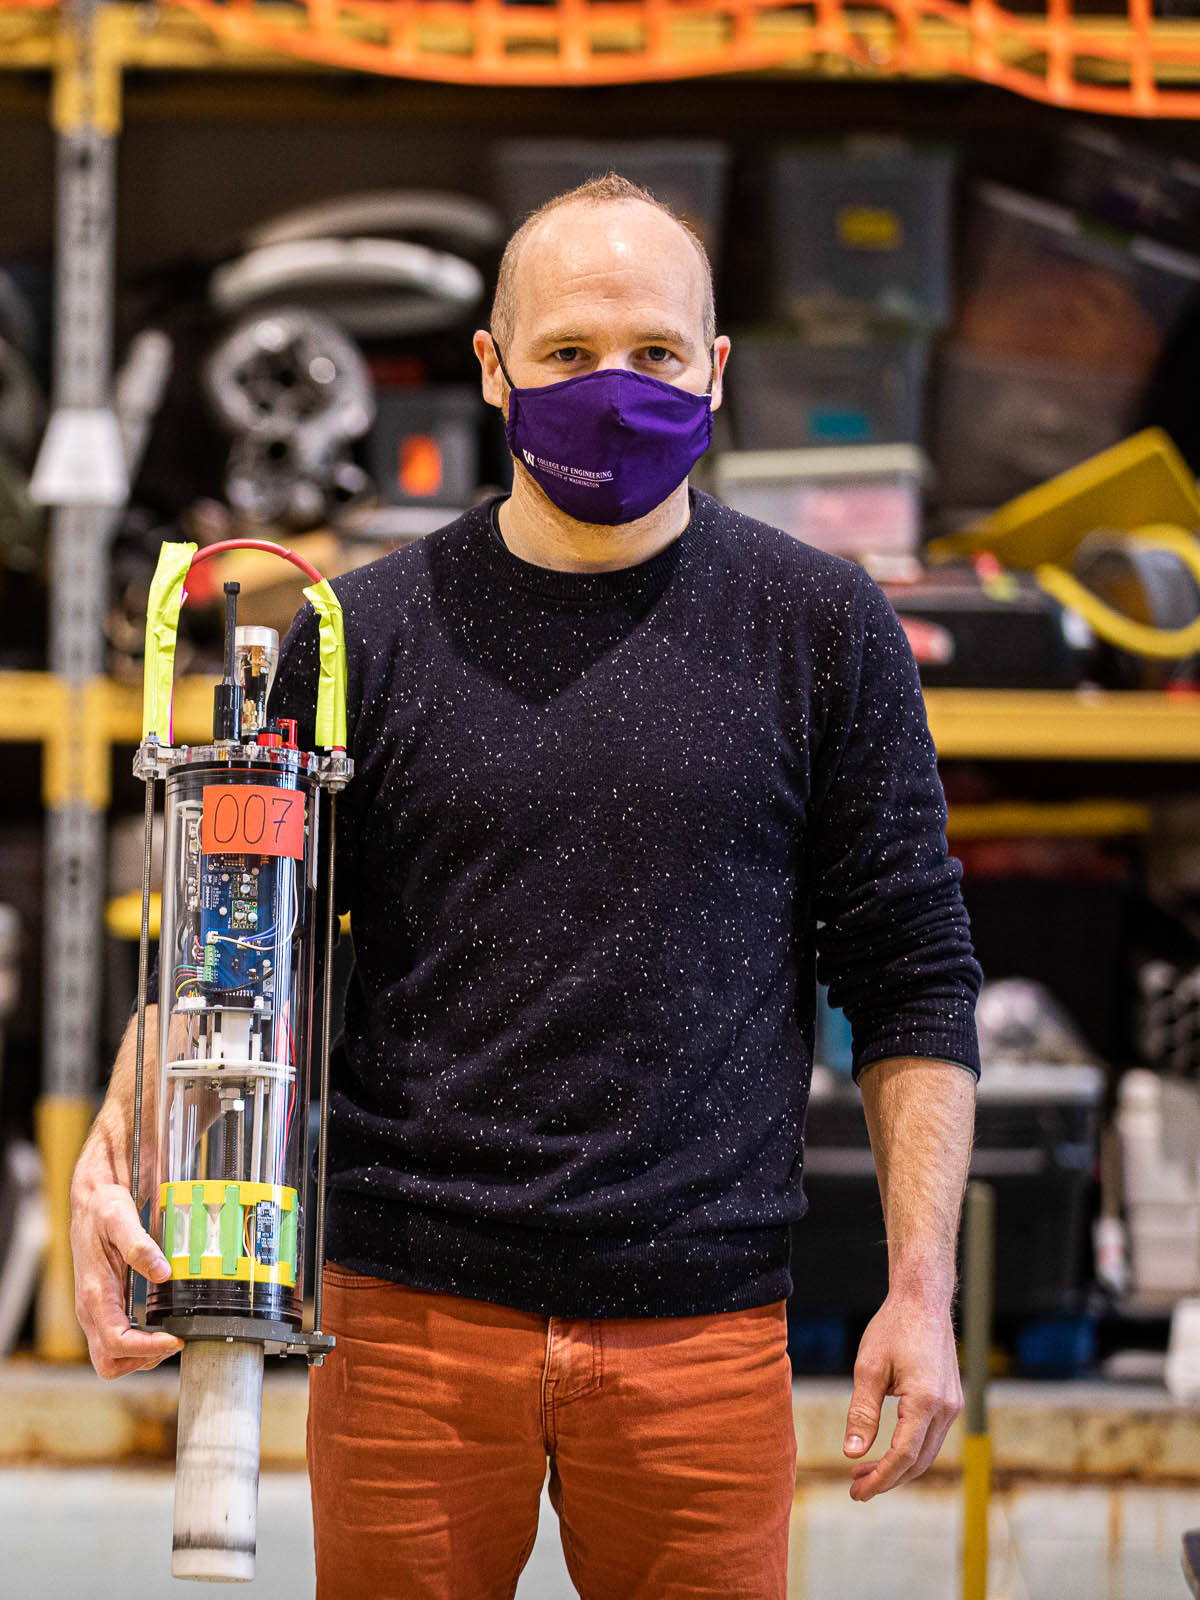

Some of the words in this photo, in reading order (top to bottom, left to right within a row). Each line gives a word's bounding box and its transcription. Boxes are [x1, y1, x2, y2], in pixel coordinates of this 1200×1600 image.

[522, 448, 535, 467] W
[537, 457, 560, 470] COLLEGE
[560, 465, 569, 473] OF
[570, 468, 612, 479] ENGINEERING
[569, 477, 600, 488] WASHINGTON
[214, 793, 294, 845] 007
